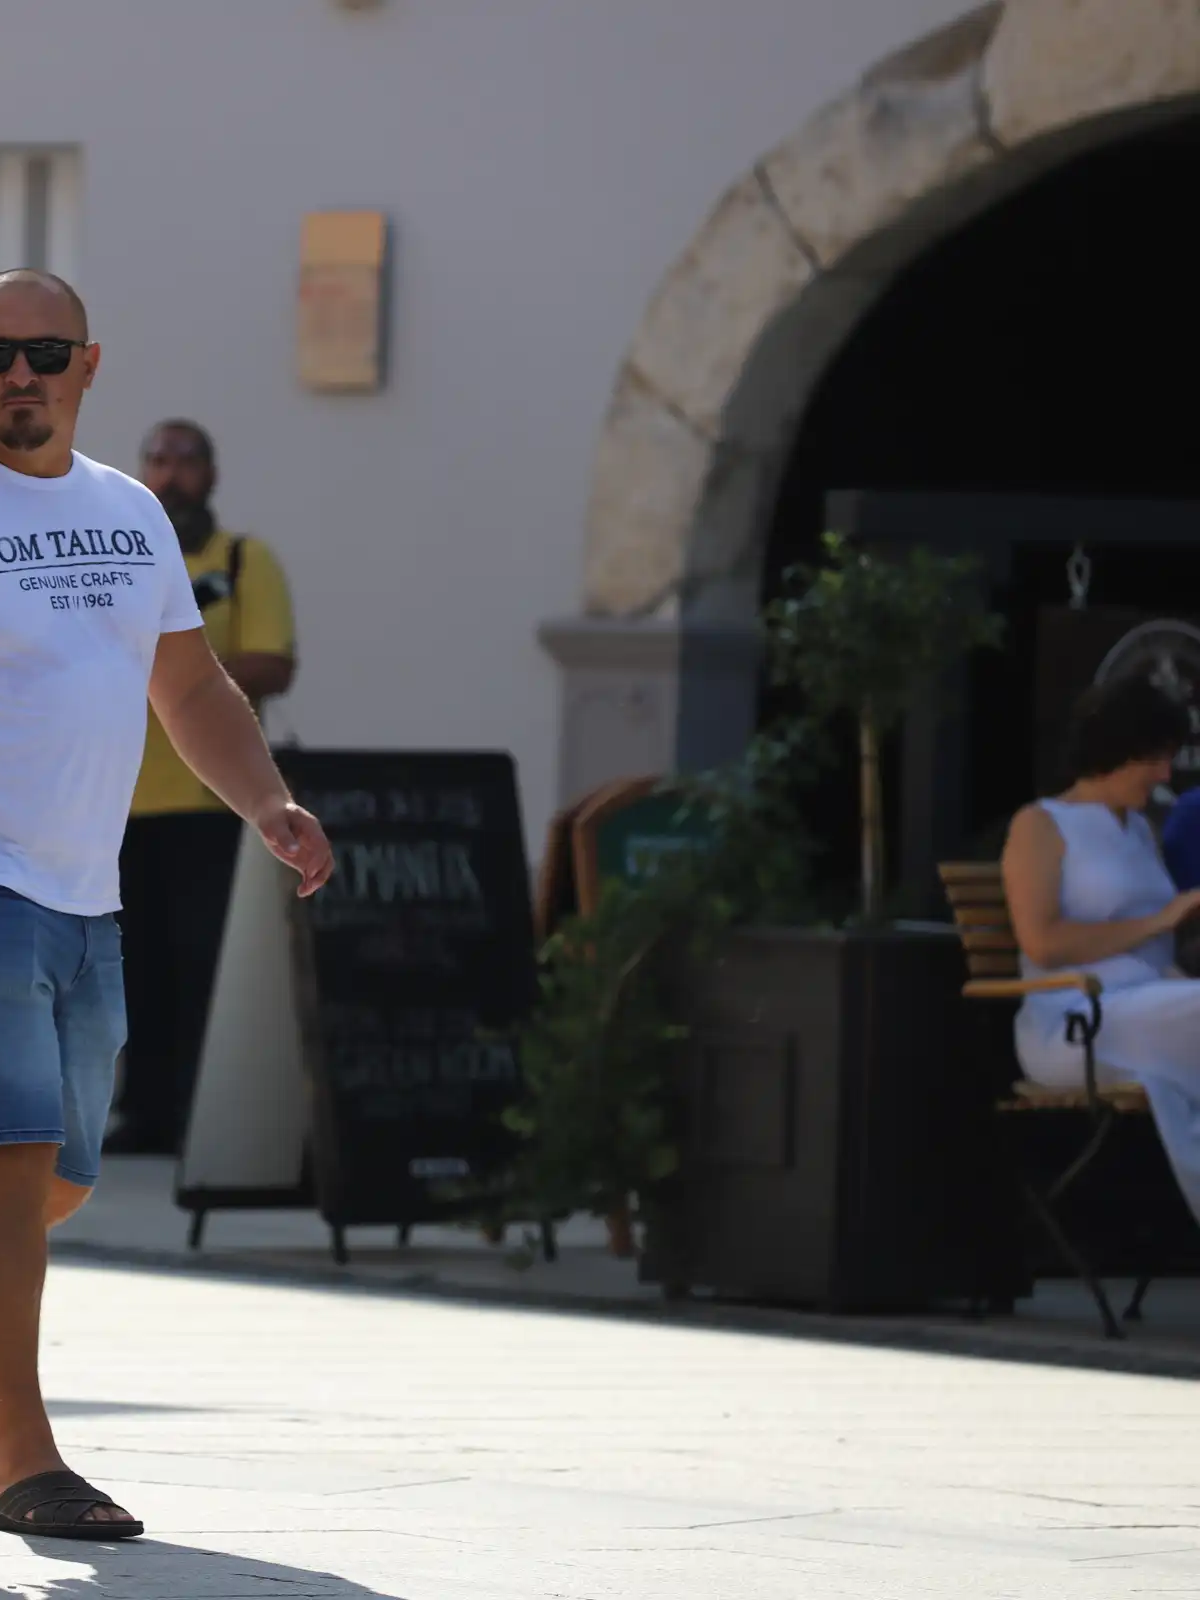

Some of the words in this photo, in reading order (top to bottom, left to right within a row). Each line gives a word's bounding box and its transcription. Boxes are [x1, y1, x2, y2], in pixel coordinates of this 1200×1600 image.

[45, 529, 154, 558] TAILOR
[19, 574, 78, 591] GENUINE
[81, 572, 133, 587] CRAFTS
[50, 595, 70, 610] EST
[83, 592, 114, 608] 1962
